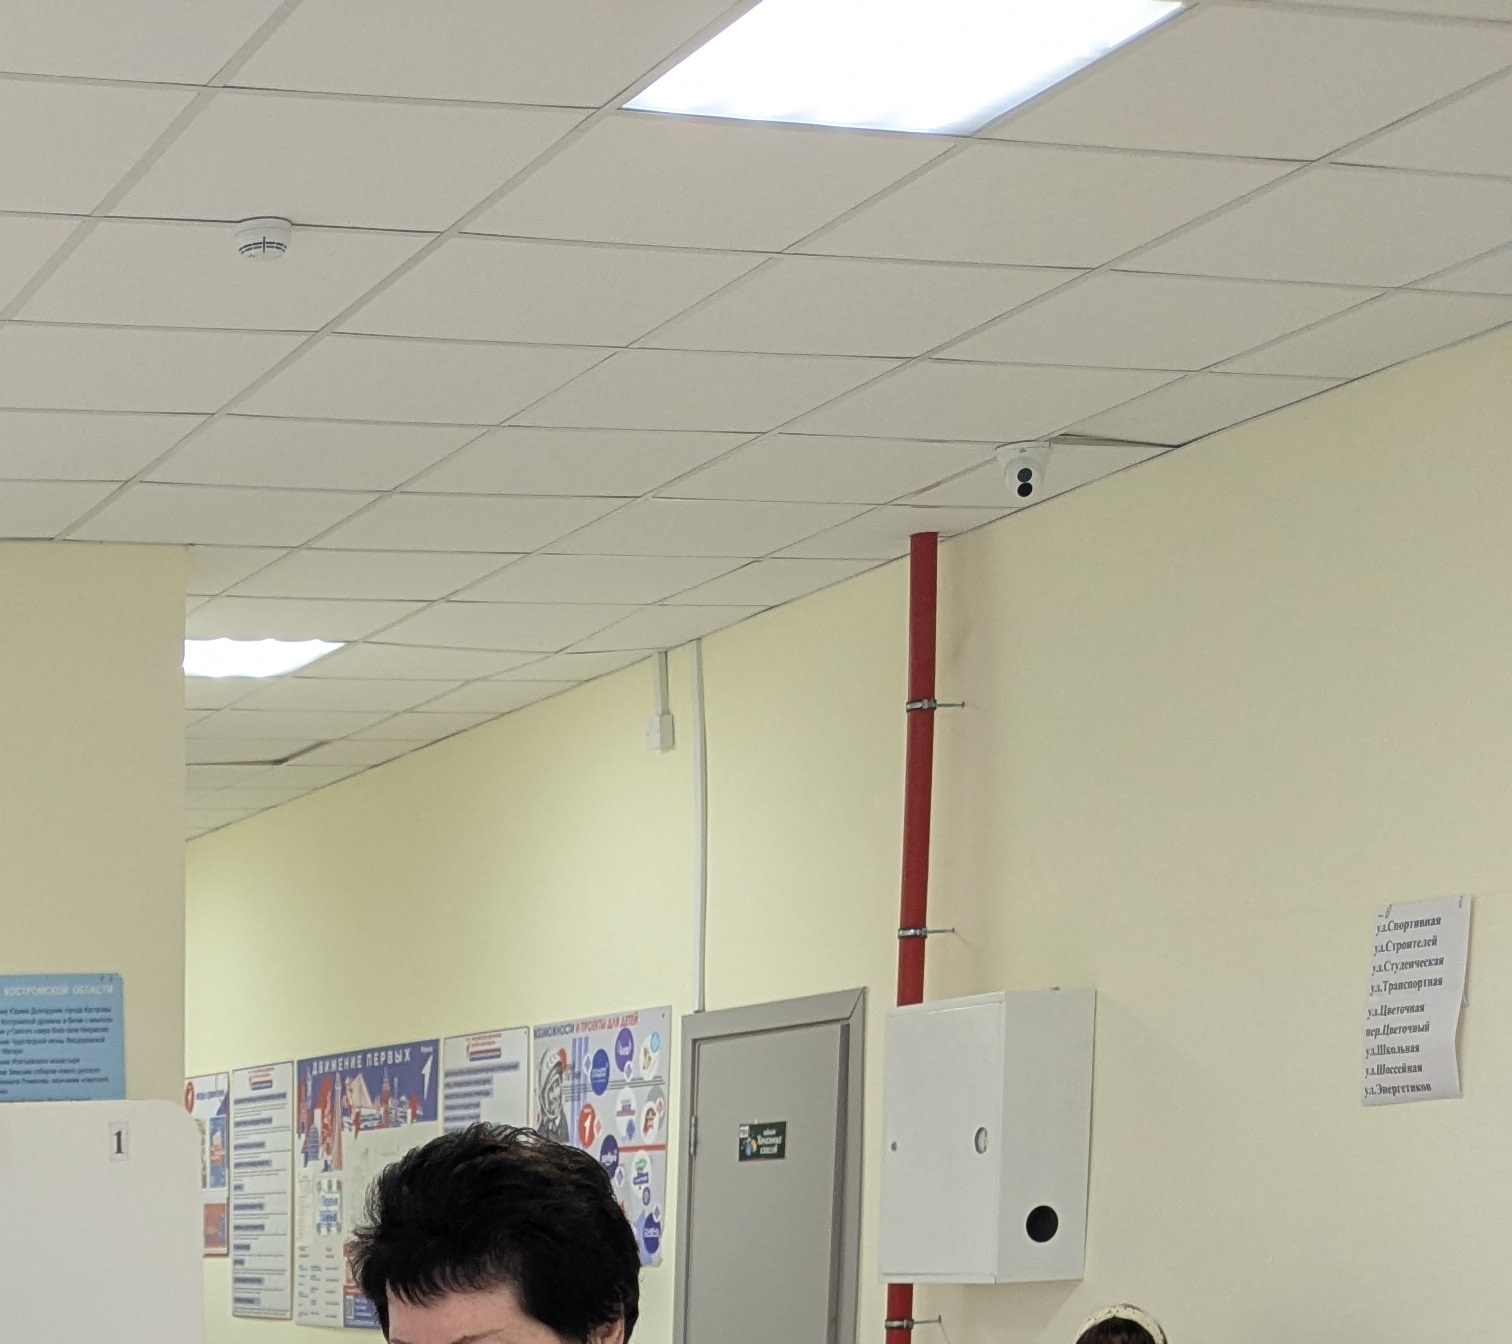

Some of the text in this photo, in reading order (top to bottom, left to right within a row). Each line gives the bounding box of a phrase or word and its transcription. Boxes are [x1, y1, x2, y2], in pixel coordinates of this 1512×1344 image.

[1373, 934, 1437, 957] ул.Строителей
[1371, 956, 1445, 976] ул.Студенческая
[1369, 977, 1444, 996] ул.Транспортная
[1366, 1003, 1425, 1020] ул.Цветочная
[1365, 1020, 1431, 1039] пер.Цветочный
[1365, 1043, 1420, 1060] ул.Школьная
[311, 1047, 411, 1076] ДВИЖЕНИЕ ПЕРВЫХ
[1364, 1062, 1423, 1079] ул.Шоссейная
[1364, 1083, 1432, 1099] ул.Энергетиков
[113, 1130, 124, 1154] 1
